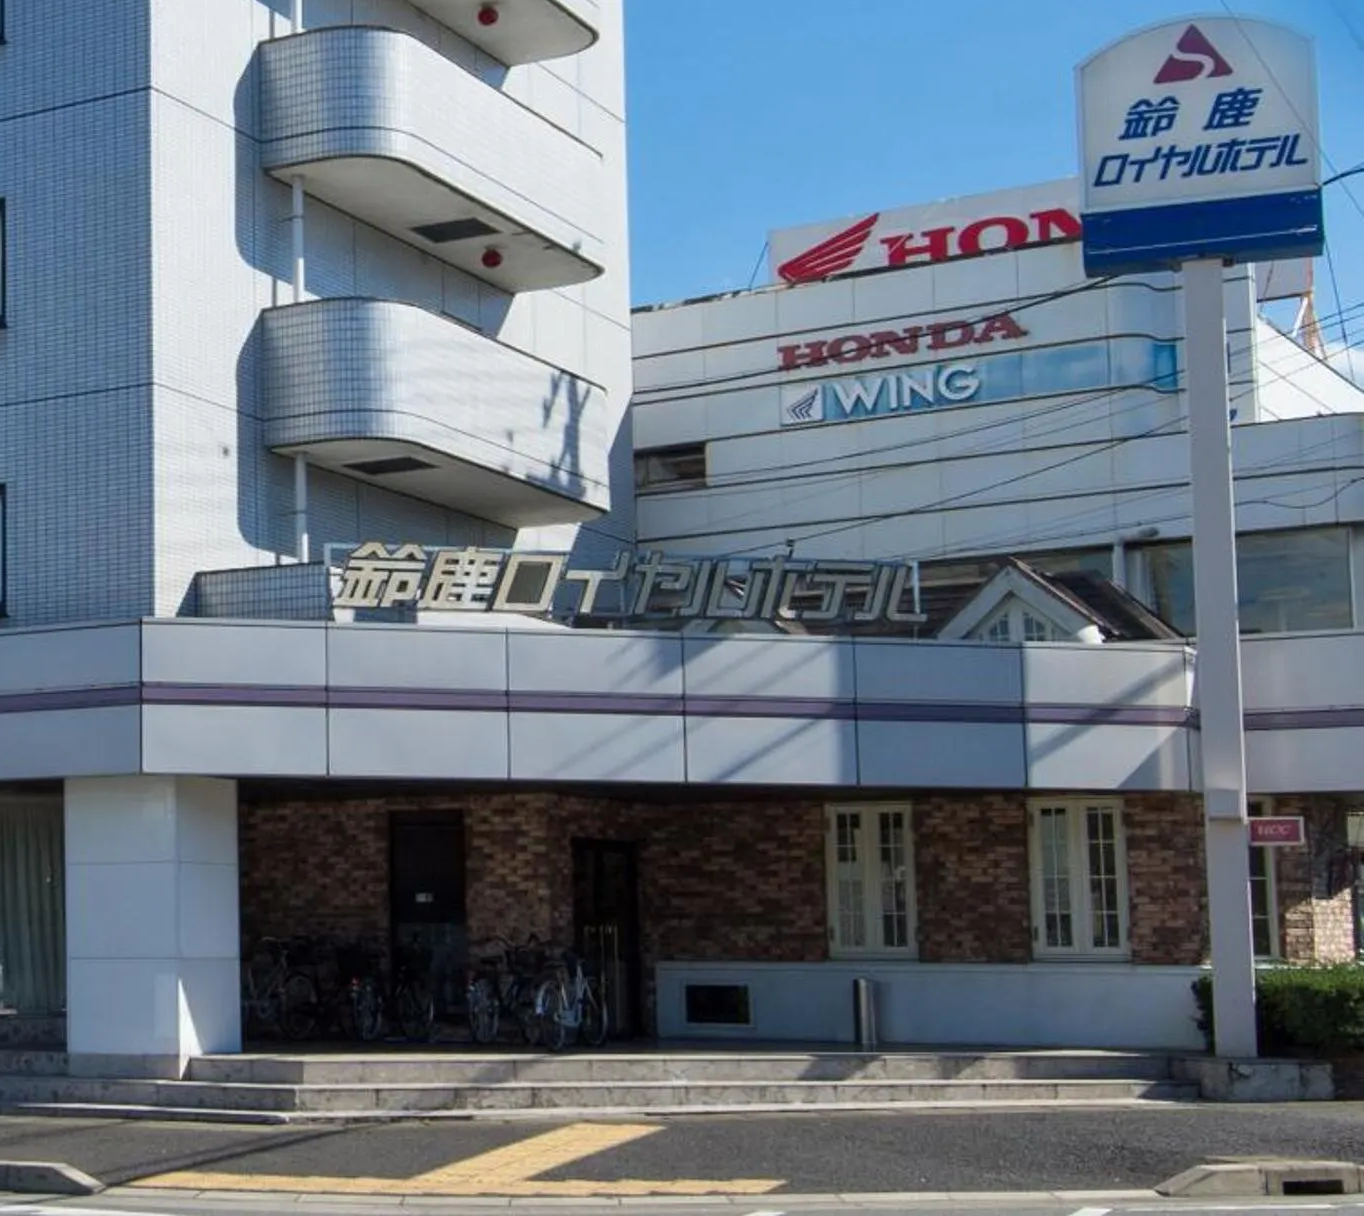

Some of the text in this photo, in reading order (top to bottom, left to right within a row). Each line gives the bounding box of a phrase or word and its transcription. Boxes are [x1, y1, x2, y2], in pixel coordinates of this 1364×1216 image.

[1118, 87, 1264, 140] 鈴鹿
[1092, 133, 1308, 187] ロイヤルホテル
[880, 207, 1083, 266] HON
[777, 311, 1030, 372] HONDA
[834, 362, 981, 416] WING
[332, 541, 928, 623] 鈴鹿ロイヤルホテル
